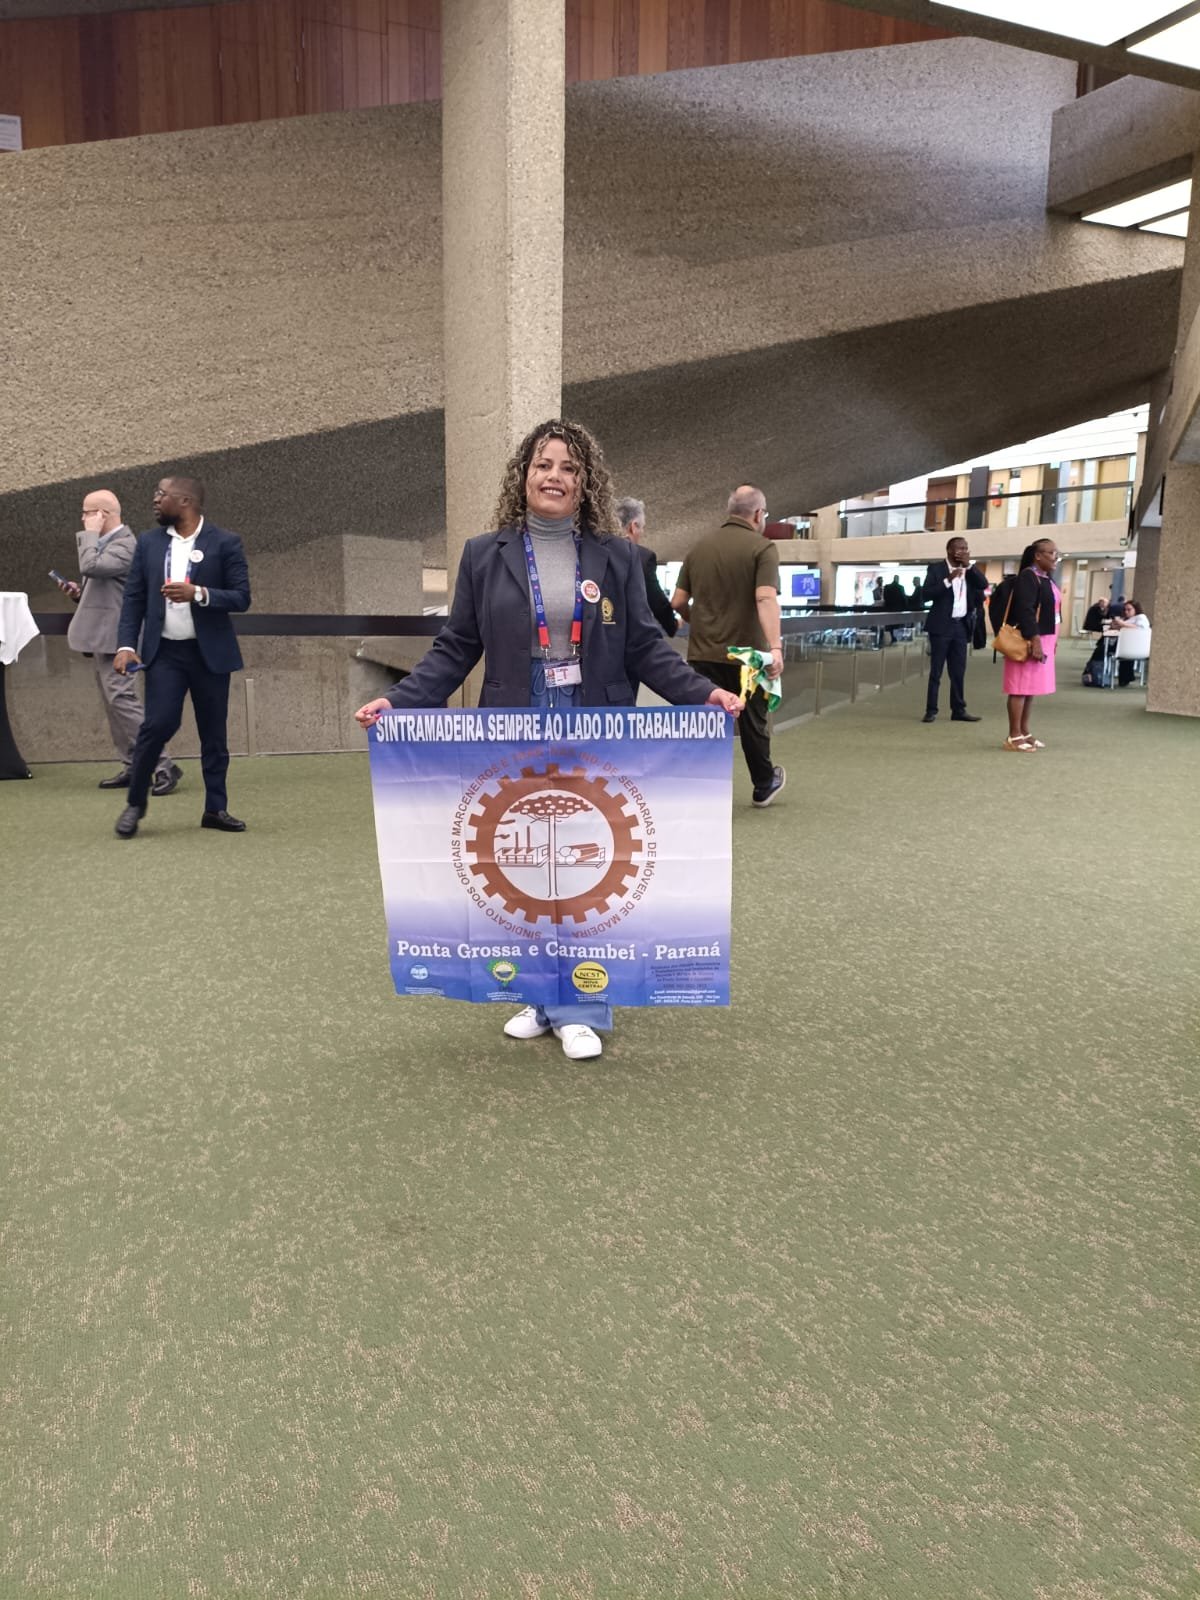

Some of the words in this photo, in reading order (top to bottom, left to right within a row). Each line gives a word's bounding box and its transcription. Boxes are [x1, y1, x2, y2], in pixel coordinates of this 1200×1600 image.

[376, 714, 485, 742] SINTRAMADEIRA
[488, 714, 541, 741] SEMPRE
[544, 713, 563, 741] AO
[566, 713, 602, 740] LADO
[605, 713, 624, 740] DO
[627, 711, 726, 739] TRABALHADOR
[451, 763, 500, 837] MARCENEIROS
[618, 775, 656, 836] SERRARIAS
[451, 839, 470, 886] OFICIAIS
[647, 842, 657, 858] DE
[631, 860, 657, 901] MÓVEIS
[467, 886, 487, 909] DOS
[619, 900, 635, 917] DE
[485, 907, 542, 939] SINDICATO
[571, 913, 622, 938] MADEIRA
[397, 940, 452, 958] Ponta
[457, 943, 522, 959] Grossa
[528, 944, 539, 956] e
[545, 941, 636, 960] Carambeí
[655, 941, 721, 960] Paraná
